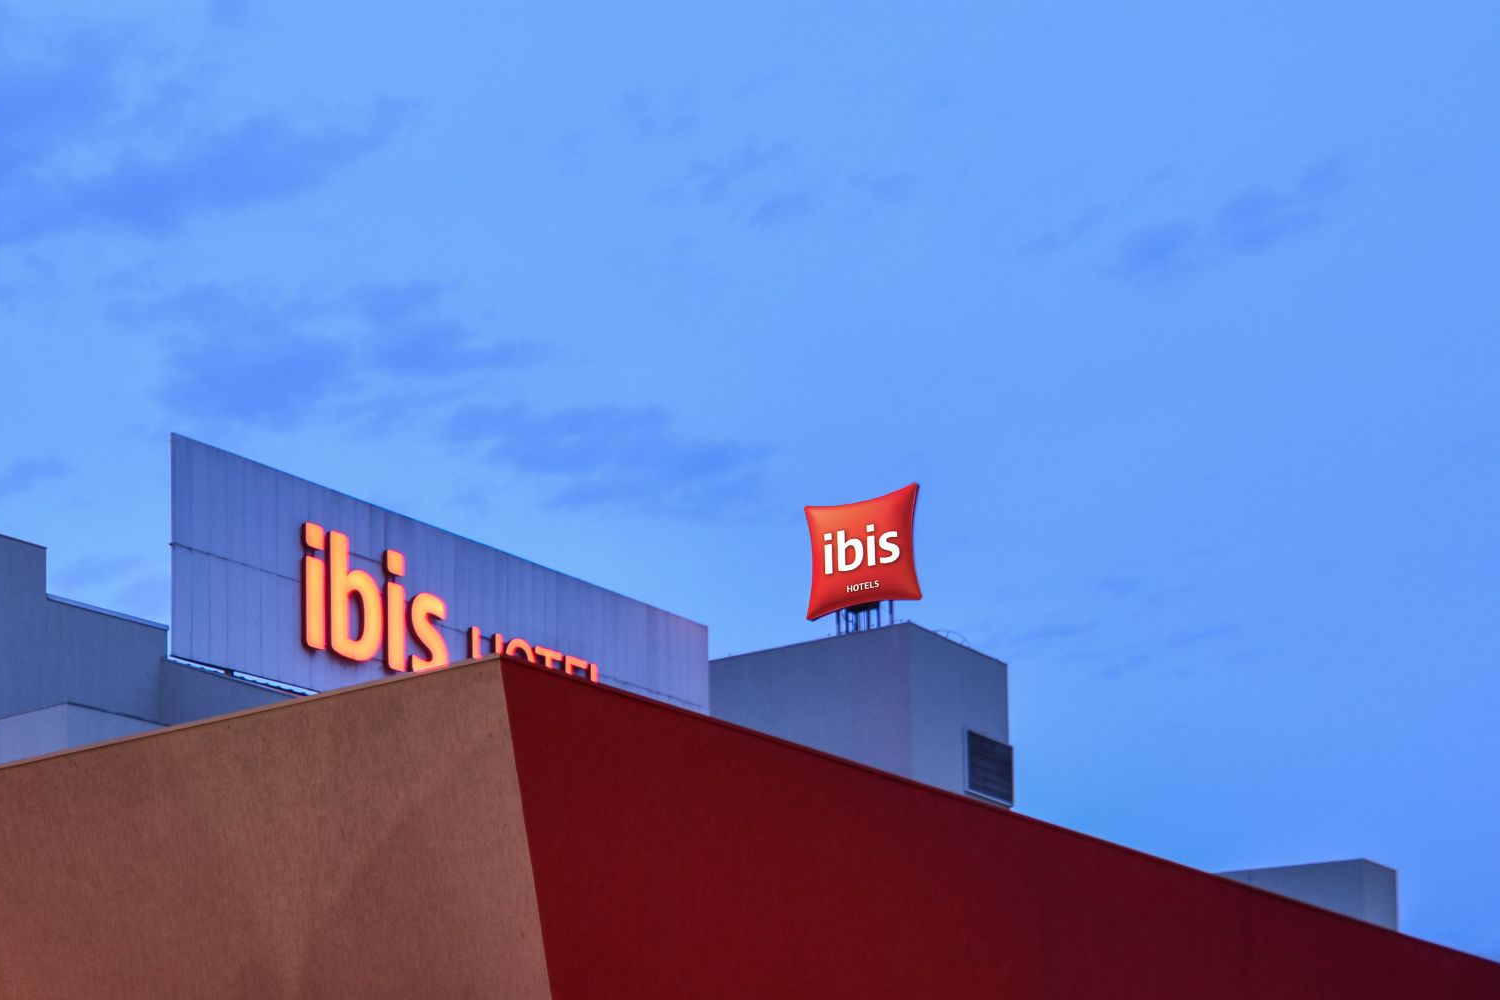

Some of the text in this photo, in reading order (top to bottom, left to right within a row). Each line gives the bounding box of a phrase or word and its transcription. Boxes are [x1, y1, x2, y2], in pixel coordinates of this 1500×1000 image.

[823, 523, 901, 575] ibis
[304, 521, 449, 672] ibis
[846, 579, 880, 593] HOTELS
